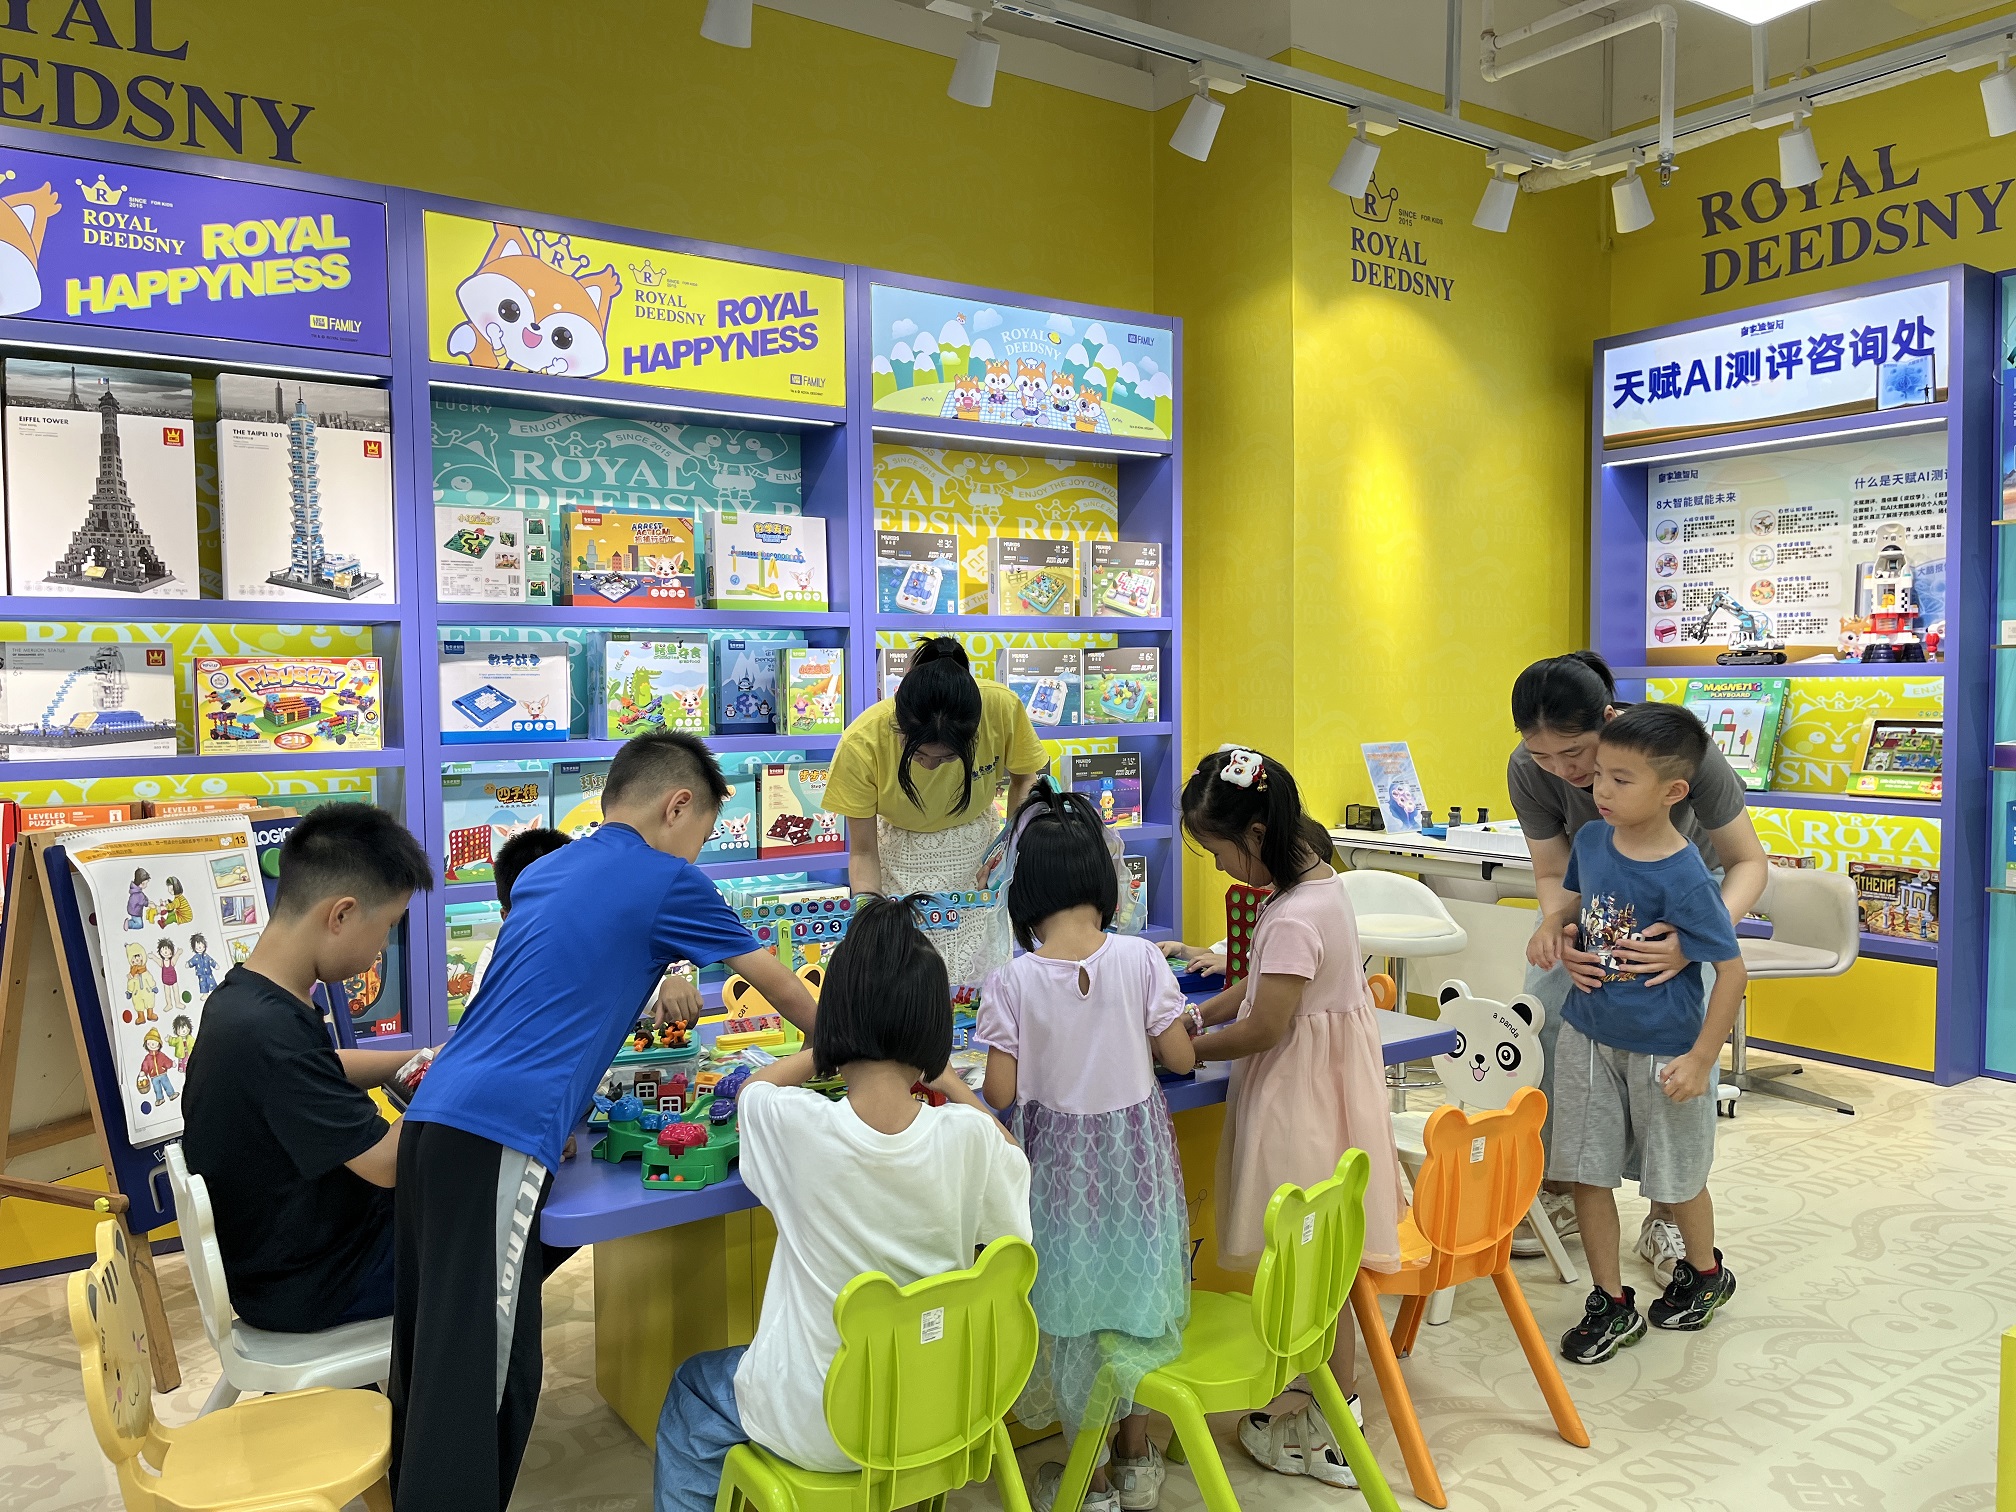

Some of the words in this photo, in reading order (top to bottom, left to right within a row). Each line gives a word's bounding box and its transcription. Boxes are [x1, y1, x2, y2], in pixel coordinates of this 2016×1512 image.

[95, 187, 109, 203] R
[1697, 144, 1920, 239] ROYAL
[129, 197, 147, 205] SINCE
[1364, 192, 1378, 216] R
[83, 209, 158, 233] ROYAL
[1398, 209, 1417, 220] SINCE
[1421, 214, 1431, 222] FOR
[1431, 217, 1444, 225] KIDS
[1398, 217, 1413, 227] 2015
[83, 228, 185, 255] DEEDSNY
[201, 214, 350, 261] ROYAL
[1701, 178, 2015, 296] DEEDSNY
[1351, 227, 1427, 266] ROYAL
[65, 254, 351, 316] HAPPYNESS
[644, 272, 652, 283] R
[1351, 258, 1455, 301] DEEDSNY
[635, 289, 687, 308] ROYAL
[635, 305, 706, 326] DEEDSNY
[718, 290, 818, 328] ROYAL
[329, 317, 362, 333] FAMILY
[1001, 328, 1049, 344] ROYAL
[623, 323, 818, 375] HAPPYNESS
[1005, 341, 1062, 361] DEEDSNY
[1612, 315, 1935, 409] 天赋AI测评咨询处
[803, 376, 826, 388] FAMILY
[436, 400, 492, 414] LUCKY
[19, 416, 41, 424] EIFFEL
[43, 417, 69, 425] TOWER
[520, 418, 563, 434] ENJOY
[569, 445, 583, 457] R
[616, 433, 648, 444] SINCE
[650, 442, 672, 458] 2015
[509, 449, 695, 490] ROYAL
[892, 457, 918, 468] SINCE
[1018, 486, 1049, 498] ENJOY
[1049, 480, 1068, 494] THE
[1068, 479, 1087, 488] JOY
[1088, 480, 1100, 489] OF
[1656, 492, 1737, 510] 8大智能赋能未来
[1051, 510, 1061, 520] R
[631, 523, 663, 531] ARREST
[488, 654, 541, 667] 数字战争
[236, 664, 345, 692] Playstix
[1704, 682, 1762, 692] MAGNETIC
[1834, 701, 1845, 709] R
[281, 737, 306, 746] 211
[496, 784, 539, 802] 四子棋
[28, 812, 66, 820] LEVELED
[113, 813, 119, 821] 1
[163, 805, 198, 814] LEVELED
[28, 819, 66, 827] PUZZLES
[235, 836, 246, 845] 13
[1853, 873, 1896, 894] ATHENA
[952, 894, 959, 902] 6
[968, 894, 973, 902] 7
[982, 893, 988, 901] 8
[932, 913, 938, 922] 9
[947, 911, 957, 921] 10
[798, 926, 803, 935] 1
[815, 923, 822, 933] 2
[832, 921, 839, 931] 3
[738, 1004, 749, 1019] cat
[1492, 1012, 1498, 1020] a
[1498, 1015, 1520, 1039] panda
[1775, 1335, 1811, 1353] SINCE
[1441, 1422, 1488, 1446] SINCE
[1894, 1455, 1925, 1477] YOU
